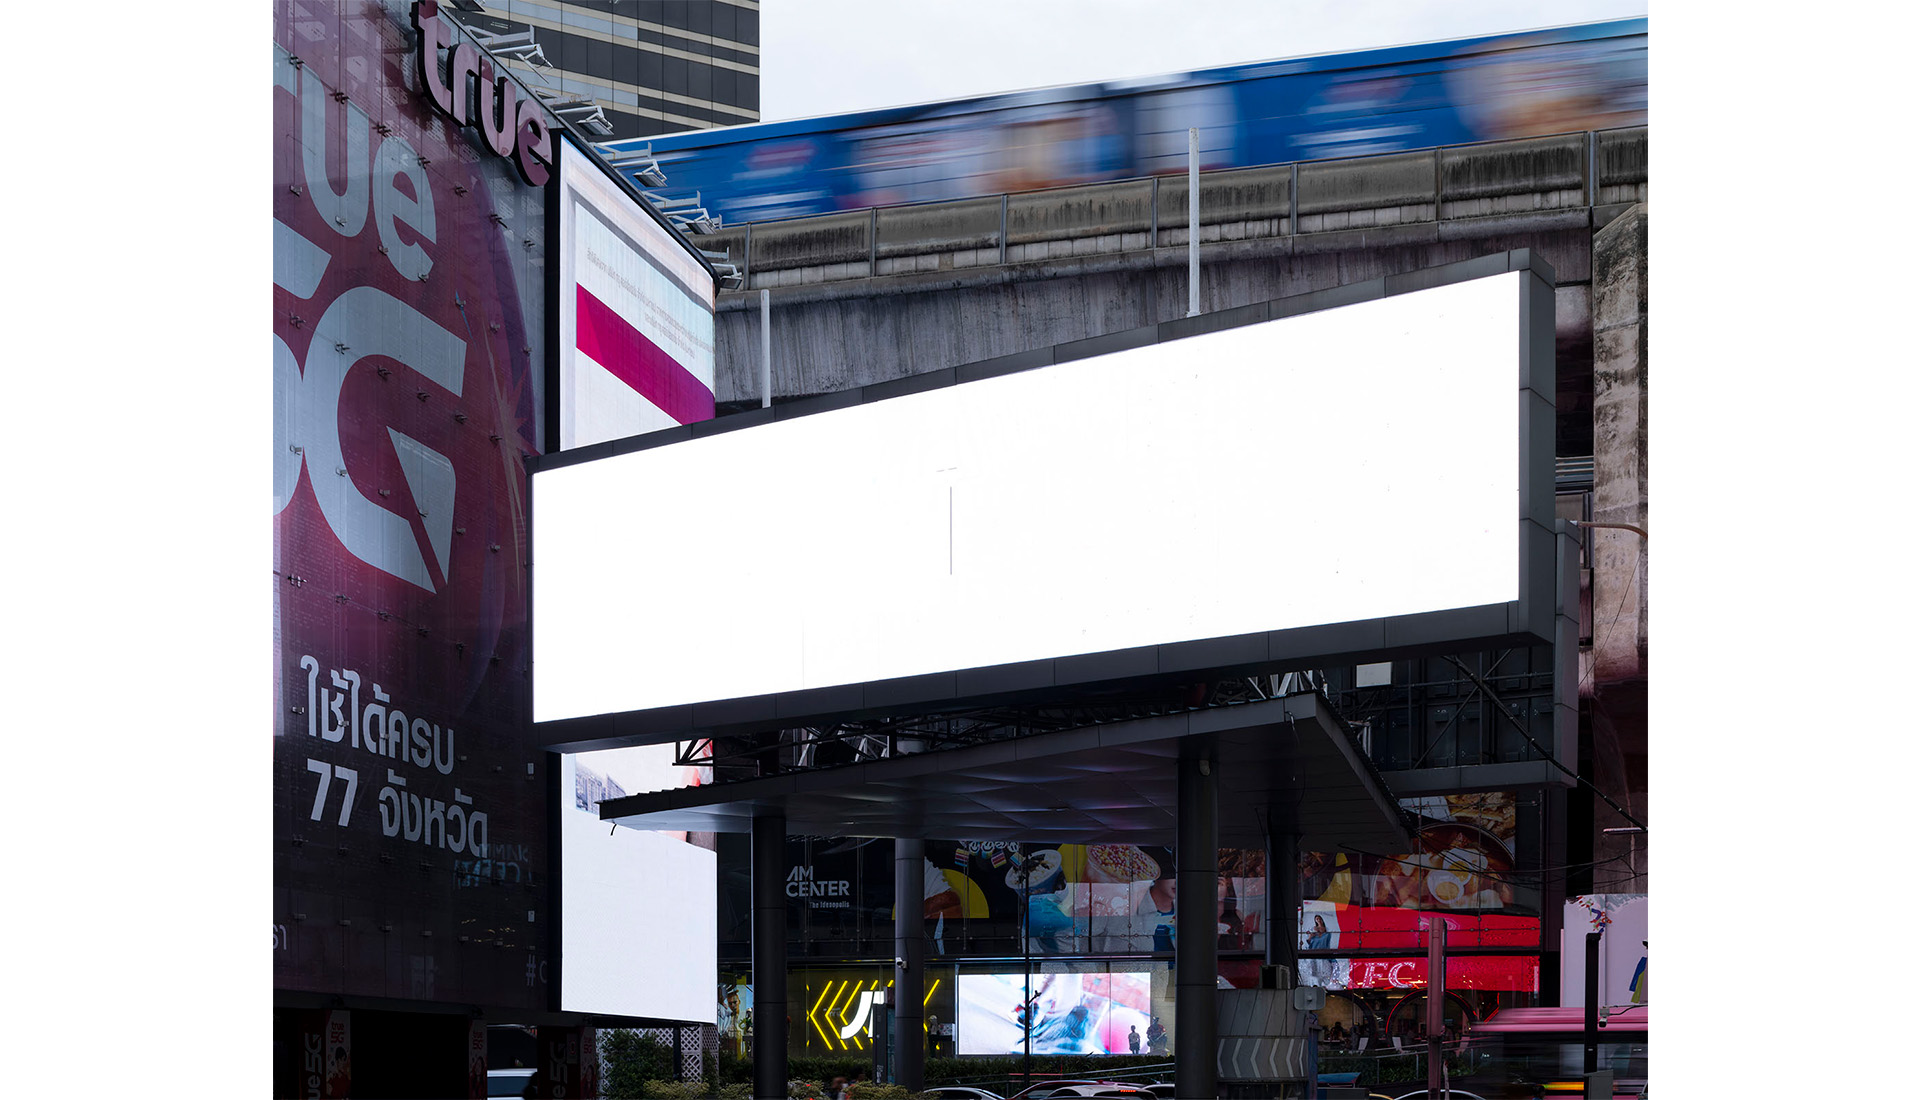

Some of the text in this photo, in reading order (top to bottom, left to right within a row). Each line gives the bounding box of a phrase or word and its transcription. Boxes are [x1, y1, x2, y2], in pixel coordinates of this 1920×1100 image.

[411, 0, 553, 187] true
[300, 654, 455, 776] ใช้ได้ครบ
[307, 757, 488, 859] 77 จังหวัด
[786, 880, 850, 898] CENTER
